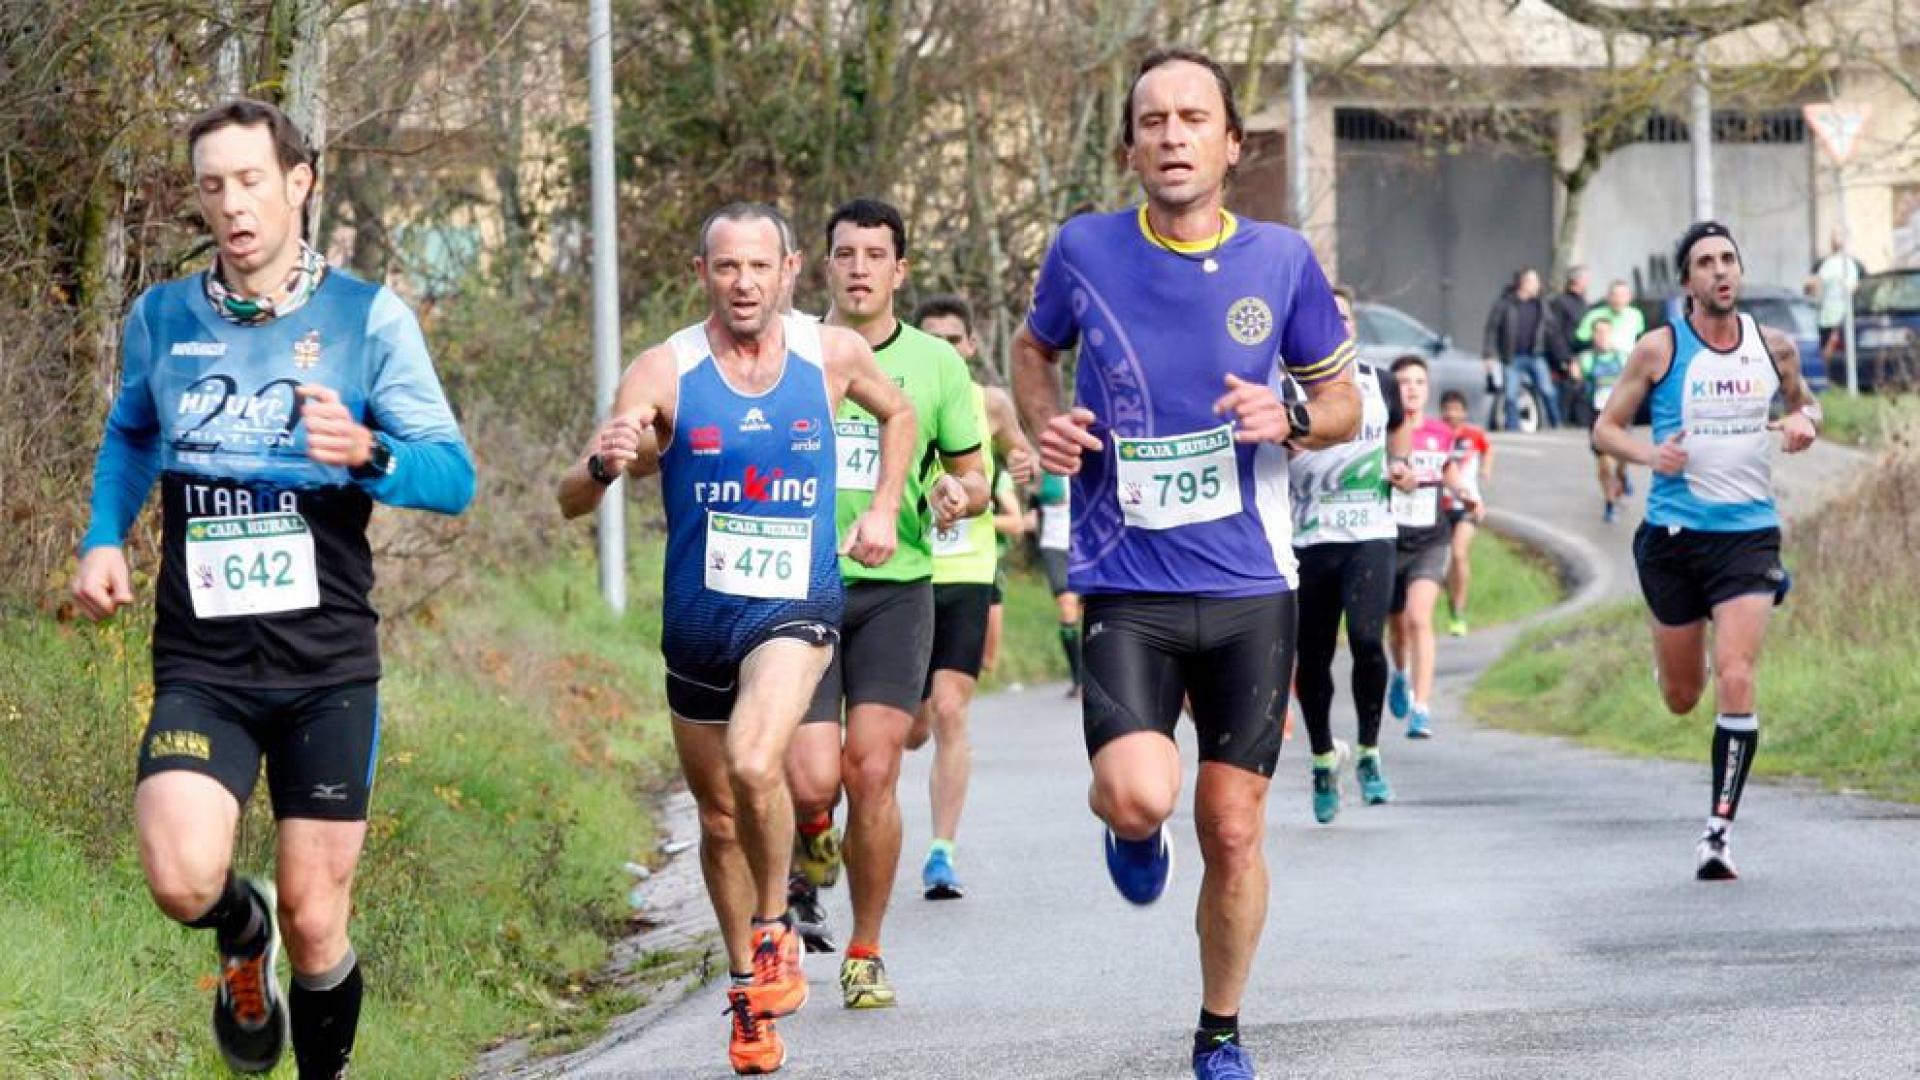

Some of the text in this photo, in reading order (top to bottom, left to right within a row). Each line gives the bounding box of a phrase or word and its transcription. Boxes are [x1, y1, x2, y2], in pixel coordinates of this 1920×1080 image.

[1152, 464, 1221, 507] 795
[1334, 509, 1369, 528] 828
[224, 550, 295, 591] 642
[733, 546, 792, 580] 476
